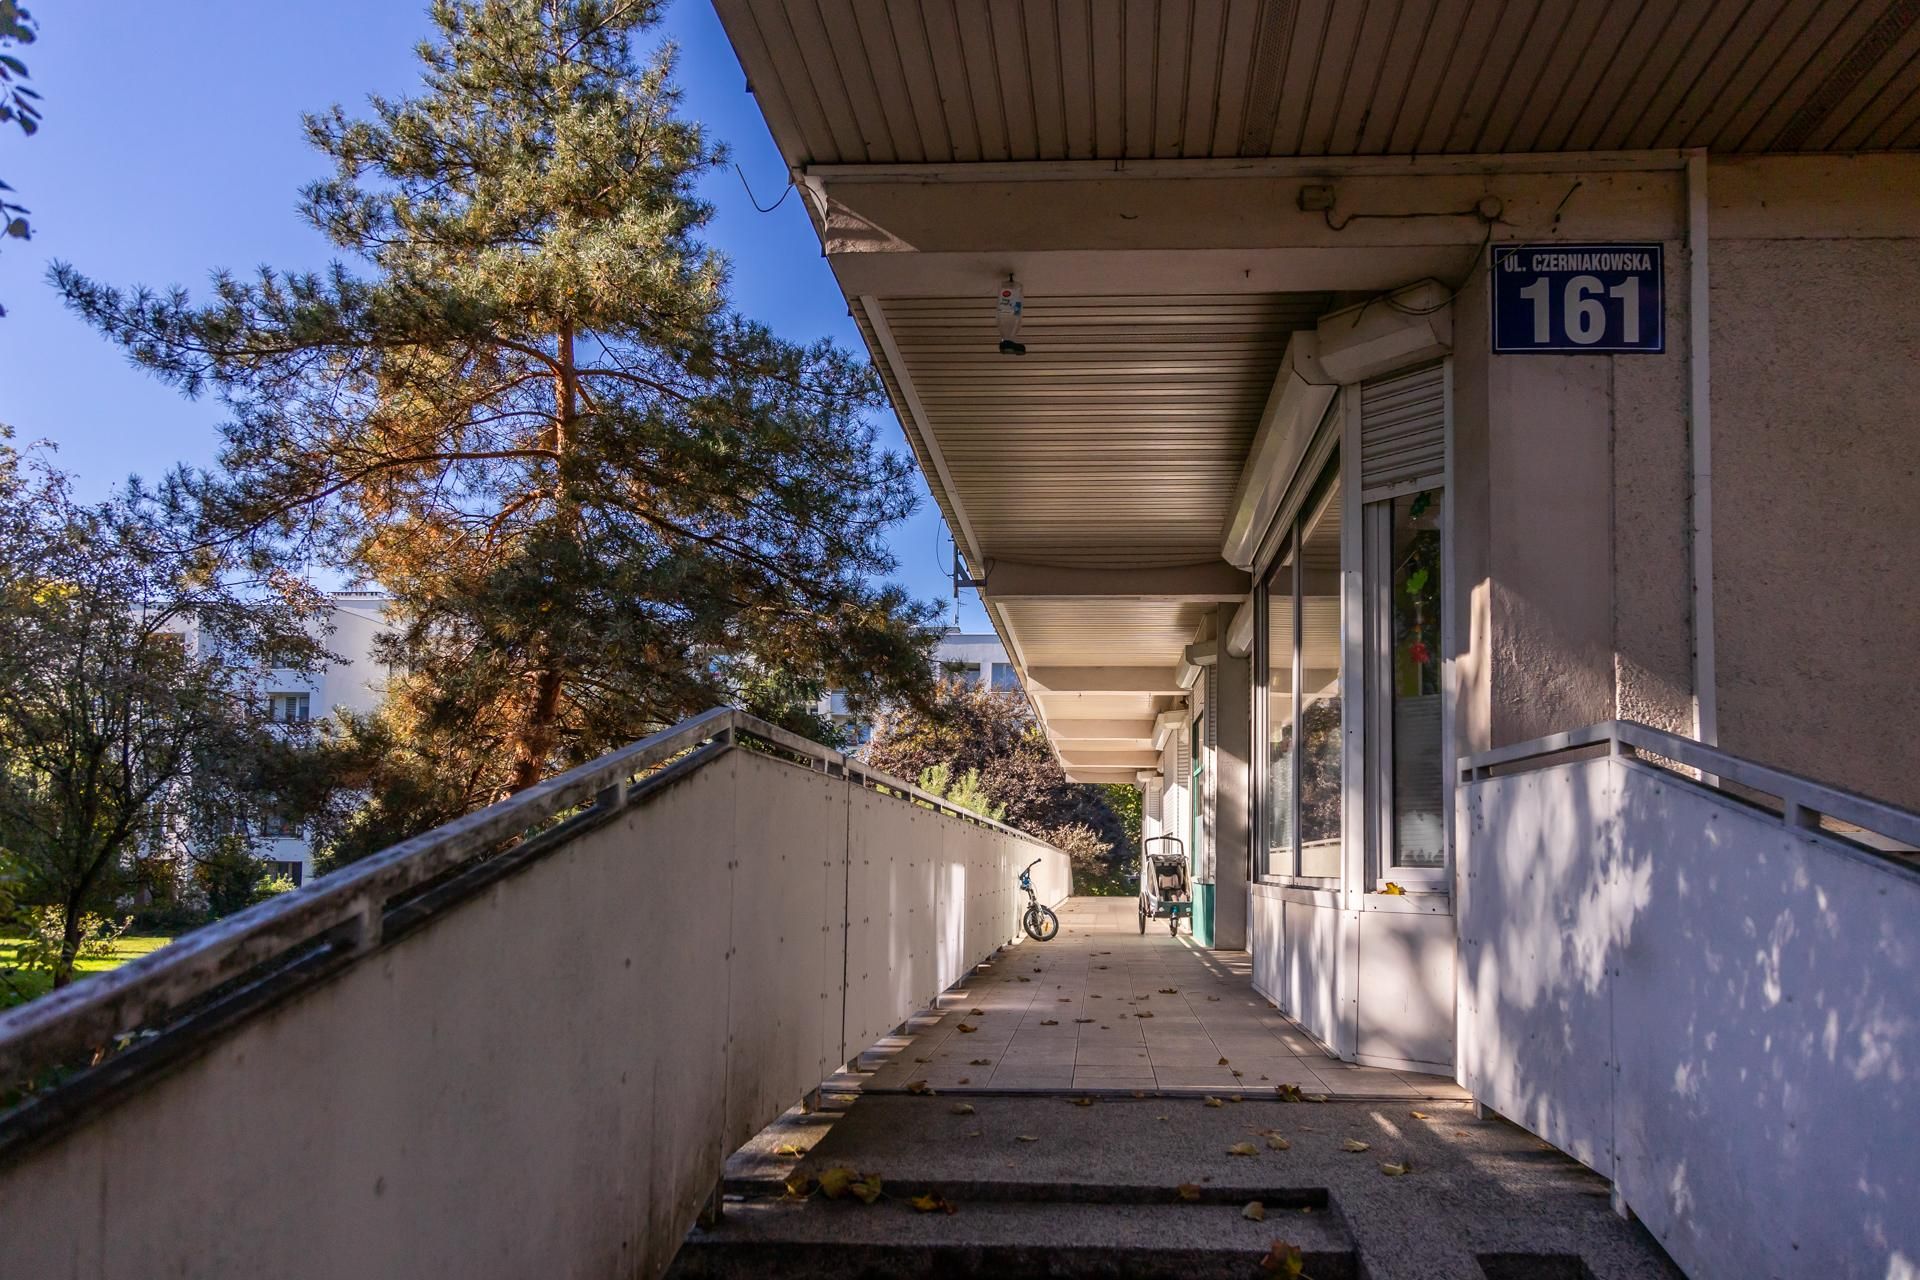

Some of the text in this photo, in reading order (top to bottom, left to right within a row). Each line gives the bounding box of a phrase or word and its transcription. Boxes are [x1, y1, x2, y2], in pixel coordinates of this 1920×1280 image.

[1504, 253, 1652, 272] UL. CZERNIAKOWSKA
[1520, 275, 1640, 345] 161
